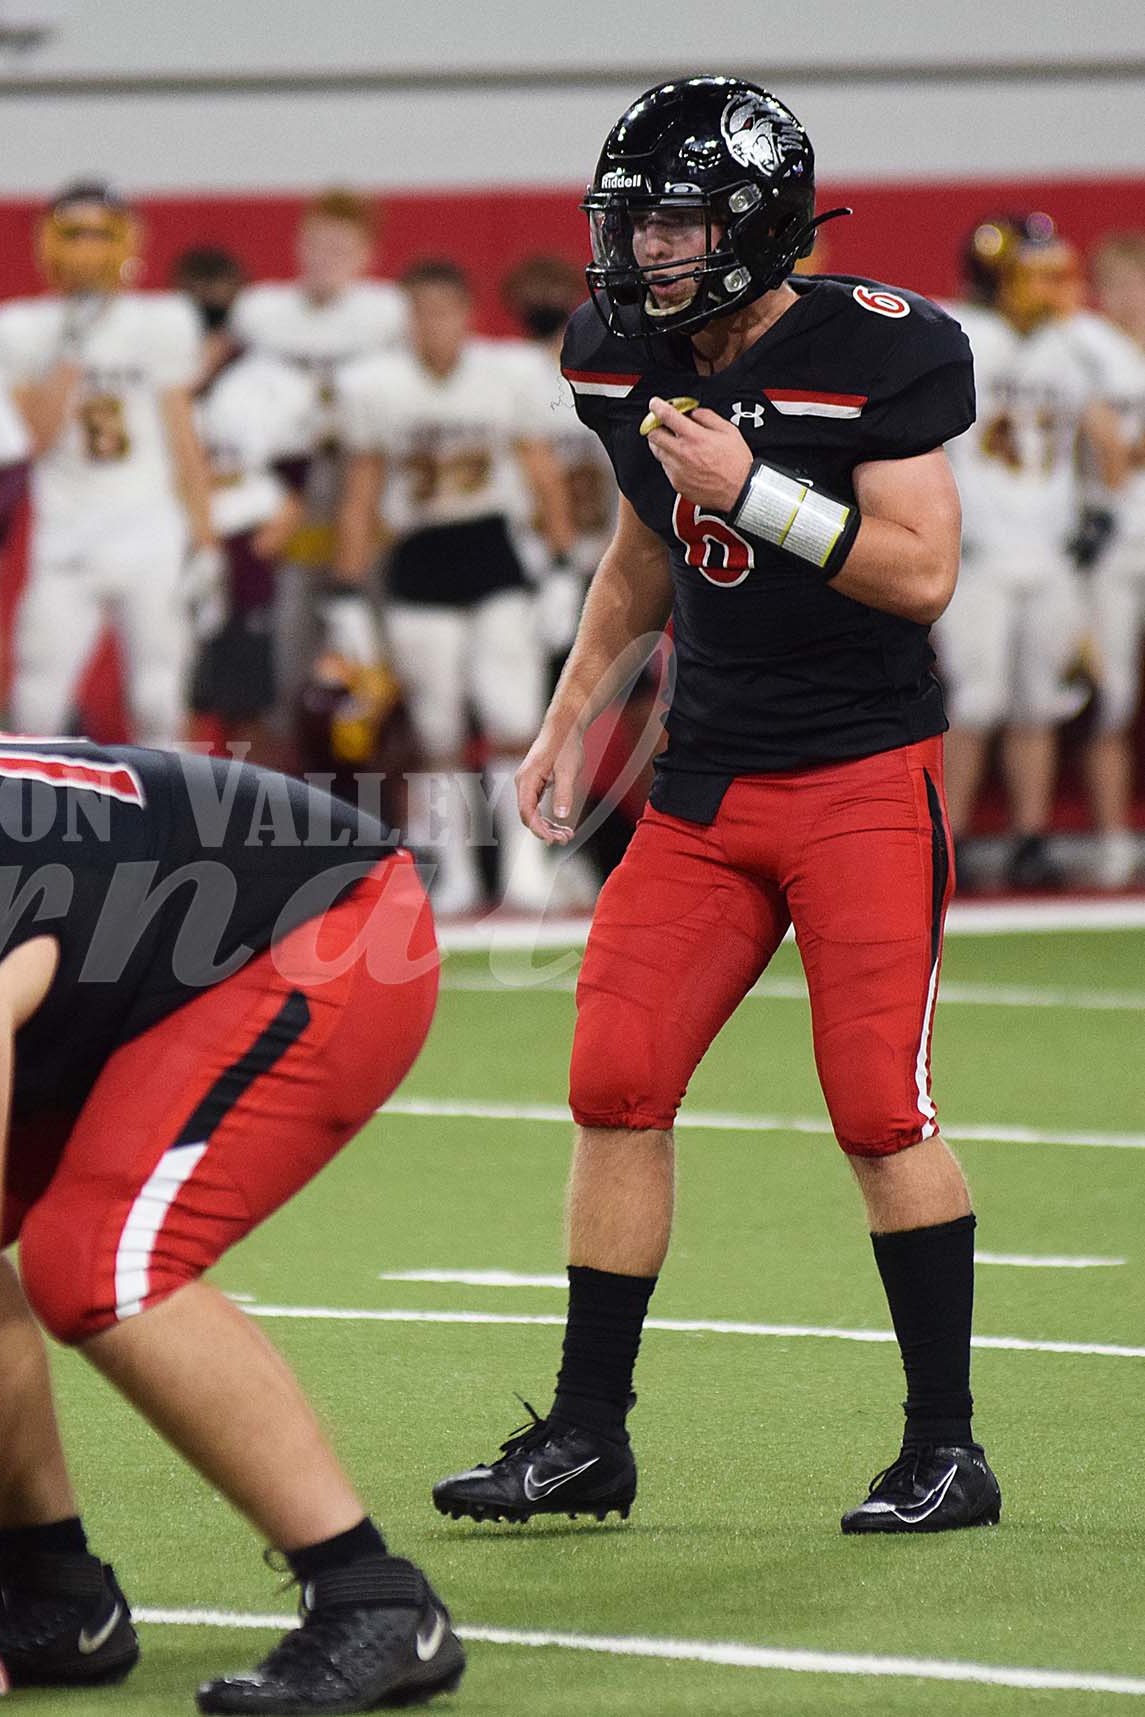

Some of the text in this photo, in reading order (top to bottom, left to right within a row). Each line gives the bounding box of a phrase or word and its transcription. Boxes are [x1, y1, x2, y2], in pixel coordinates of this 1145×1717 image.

[601, 172, 642, 189] Riddell
[853, 285, 910, 318] 6
[672, 493, 755, 588] 6
